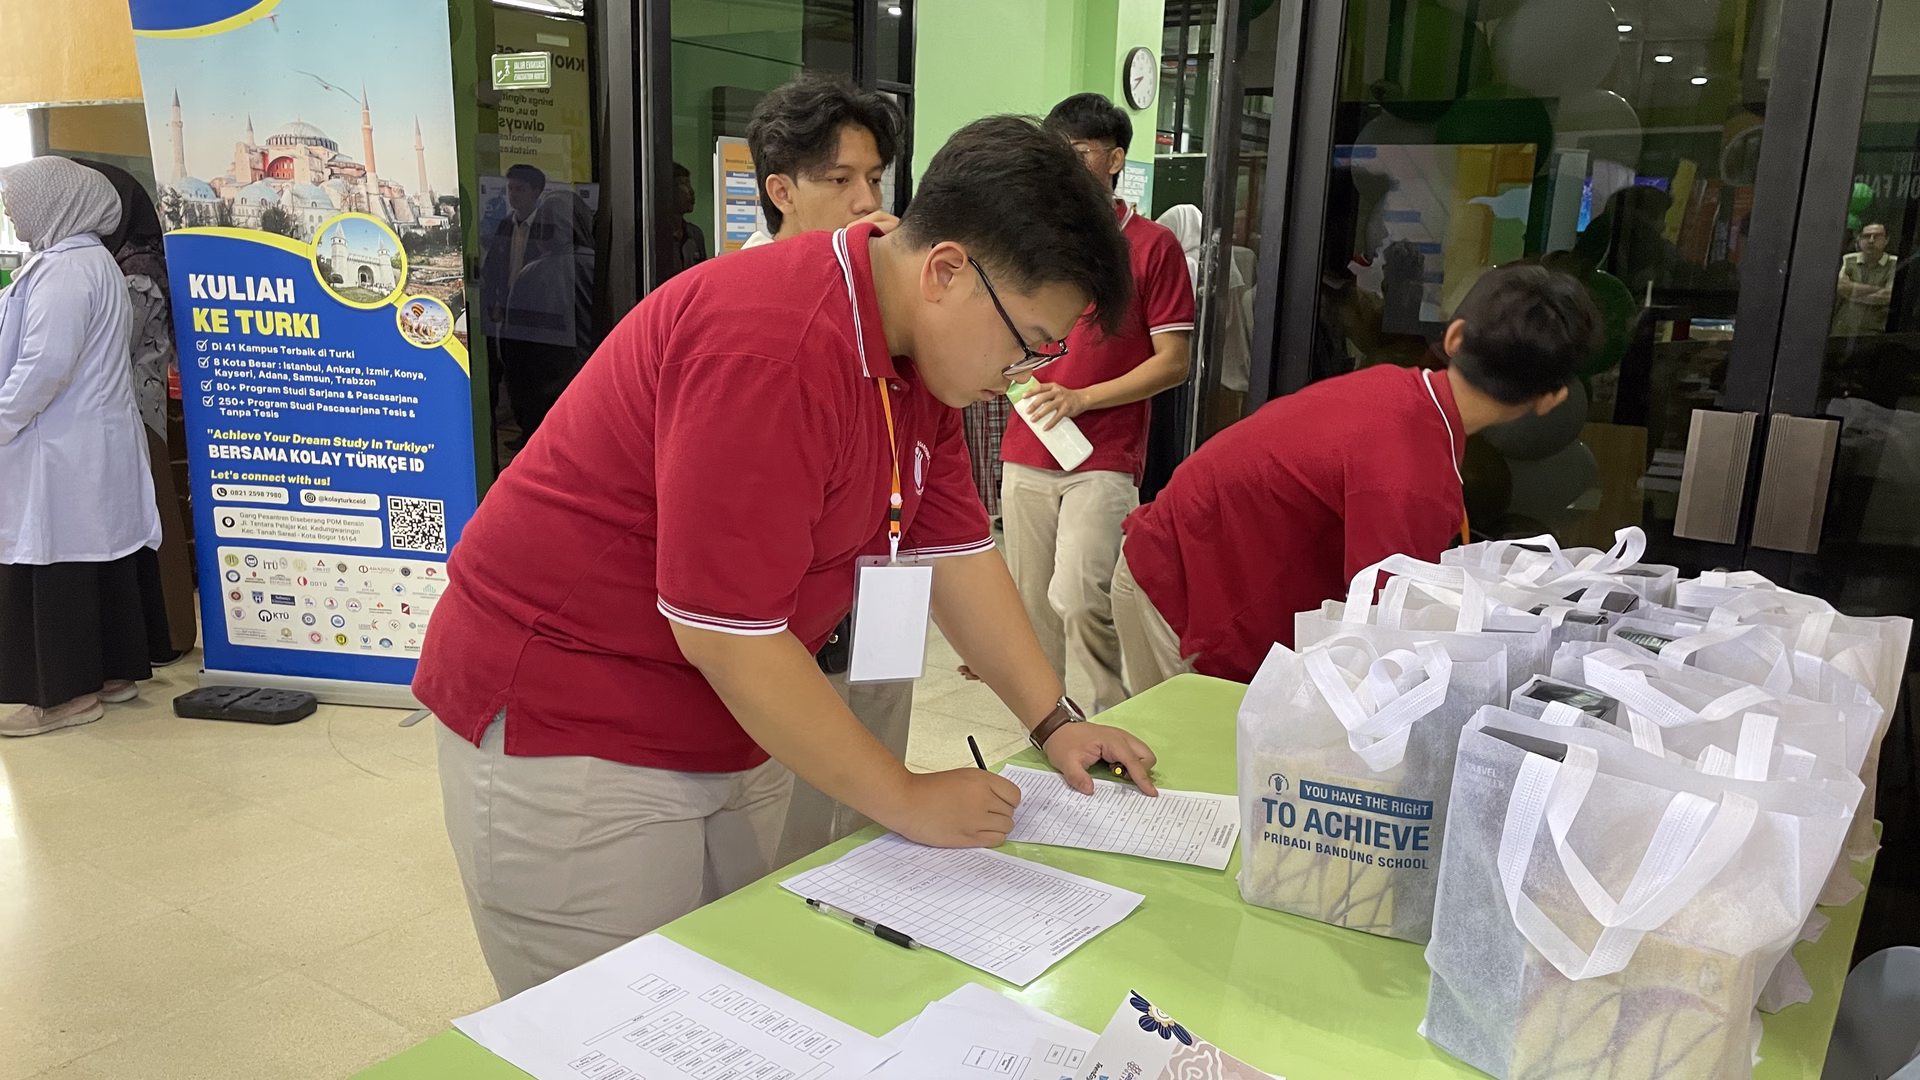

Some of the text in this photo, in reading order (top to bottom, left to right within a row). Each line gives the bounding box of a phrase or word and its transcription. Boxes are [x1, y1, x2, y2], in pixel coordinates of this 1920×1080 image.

[189, 274, 295, 304] KULIAH
[192, 308, 320, 339] KE TURKI
[212, 343, 355, 359] Di 41 Kampus Terbaik di Turki
[214, 358, 220, 366] 8
[223, 359, 246, 367] Kota
[249, 360, 277, 369] Besar
[283, 361, 324, 373] Istanbul,
[326, 365, 364, 375] Ankara,
[366, 367, 393, 378] Izmir,
[394, 369, 427, 381] Konya,
[214, 369, 376, 386] Kayseri, Adana, Samsun, Trabzon
[216, 383, 419, 404] 80+ Program Studi Sarjana & Pascasarjana
[218, 397, 416, 418] 250+ Program Studi Pascasarjana Tesis &
[219, 408, 279, 419] Tanpa Tesis
[207, 429, 261, 441] "Achieve
[264, 431, 291, 443] Your
[293, 433, 331, 446] Dream
[333, 437, 369, 449] Study
[209, 444, 425, 474] BERSAMA KOLAY TÜRKÇE ID
[211, 470, 331, 487] Let's connect with us!
[230, 489, 282, 499] 0821 2598 7980
[239, 512, 256, 520] Gang
[258, 513, 289, 522] Pesantren
[343, 519, 364, 527] Bensin
[250, 521, 274, 529] Tentara
[275, 522, 296, 532] Pelajar
[241, 527, 255, 535] Kec.
[277, 530, 296, 538] Sareal
[318, 533, 336, 542] Bogor
[338, 534, 357, 543] 16164
[263, 560, 279, 571] İTÜ
[273, 612, 290, 620] KTÜ
[1304, 785, 1429, 816] YOU HAVE THE RIGHT
[1261, 798, 1296, 829] TO
[1303, 808, 1430, 851] ACHIEVE
[1264, 832, 1429, 870] PRIBADI BANDUNG SCHOOL
